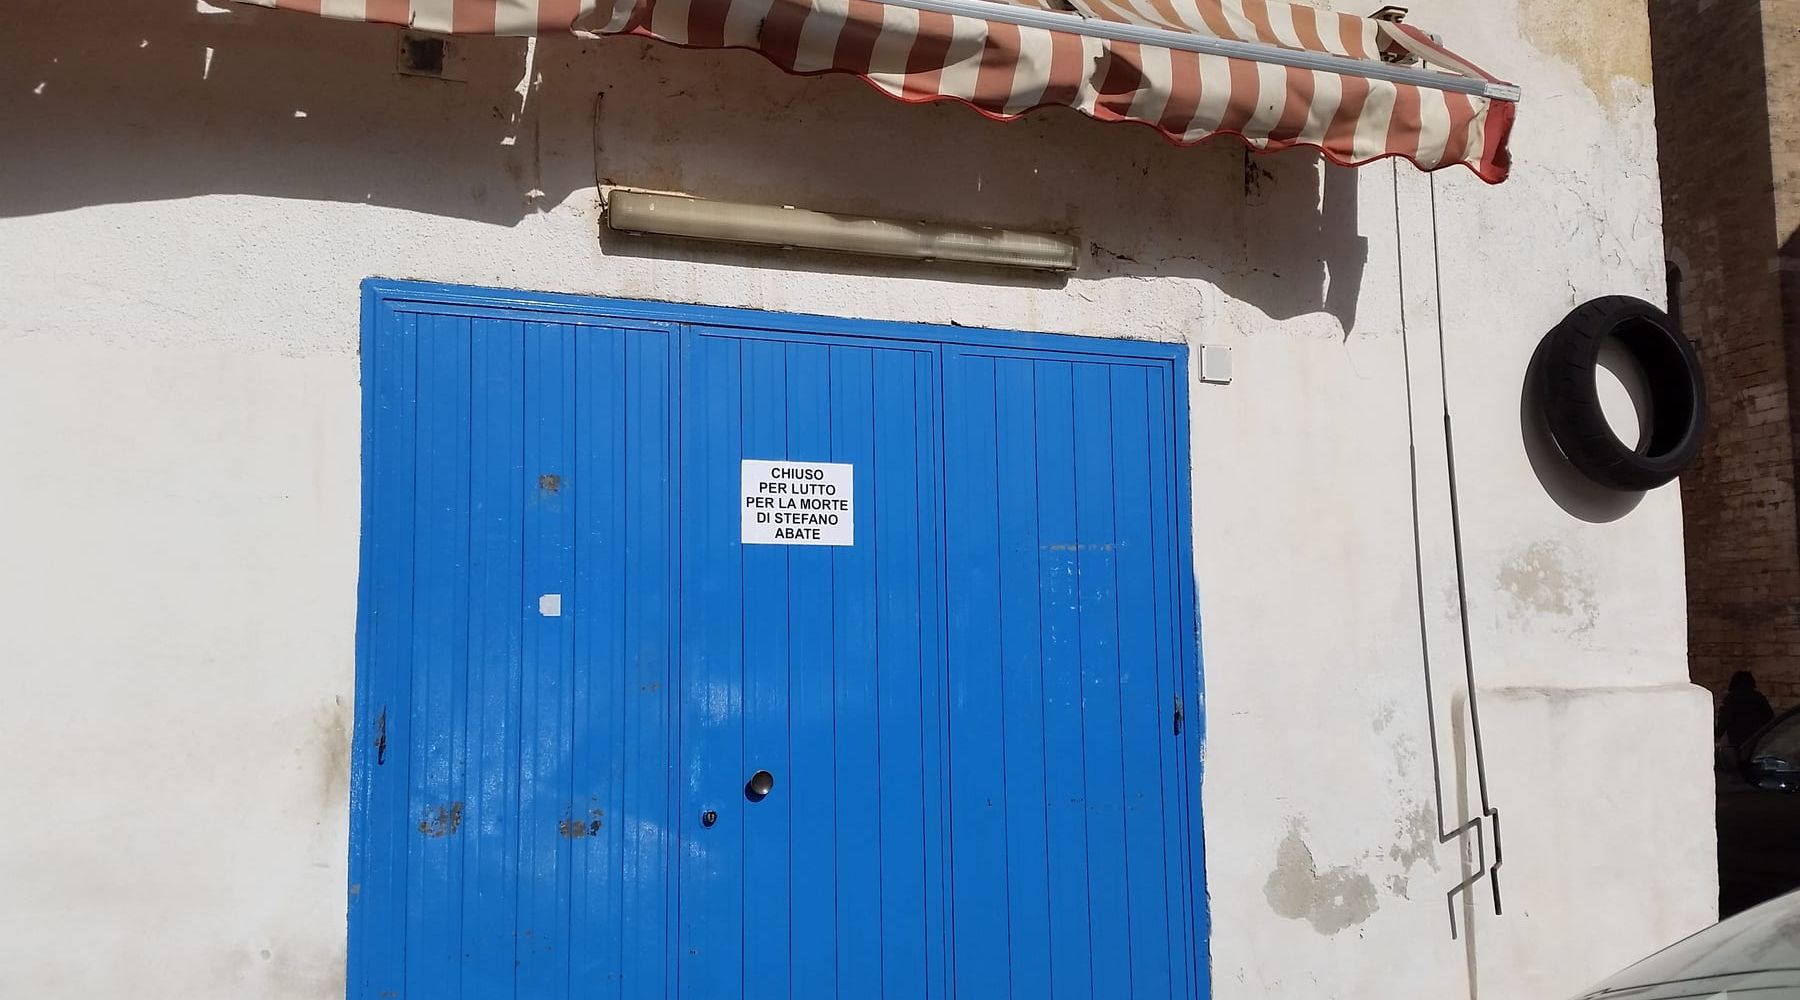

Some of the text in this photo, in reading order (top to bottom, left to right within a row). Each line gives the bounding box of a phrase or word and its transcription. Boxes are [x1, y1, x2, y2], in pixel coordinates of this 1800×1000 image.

[771, 467, 824, 480] CHIUSO
[759, 482, 836, 495] PER LUTTO
[746, 496, 848, 511] PER LA MORTE
[757, 512, 839, 525] DI STEFANO
[775, 528, 821, 539] ABATE
